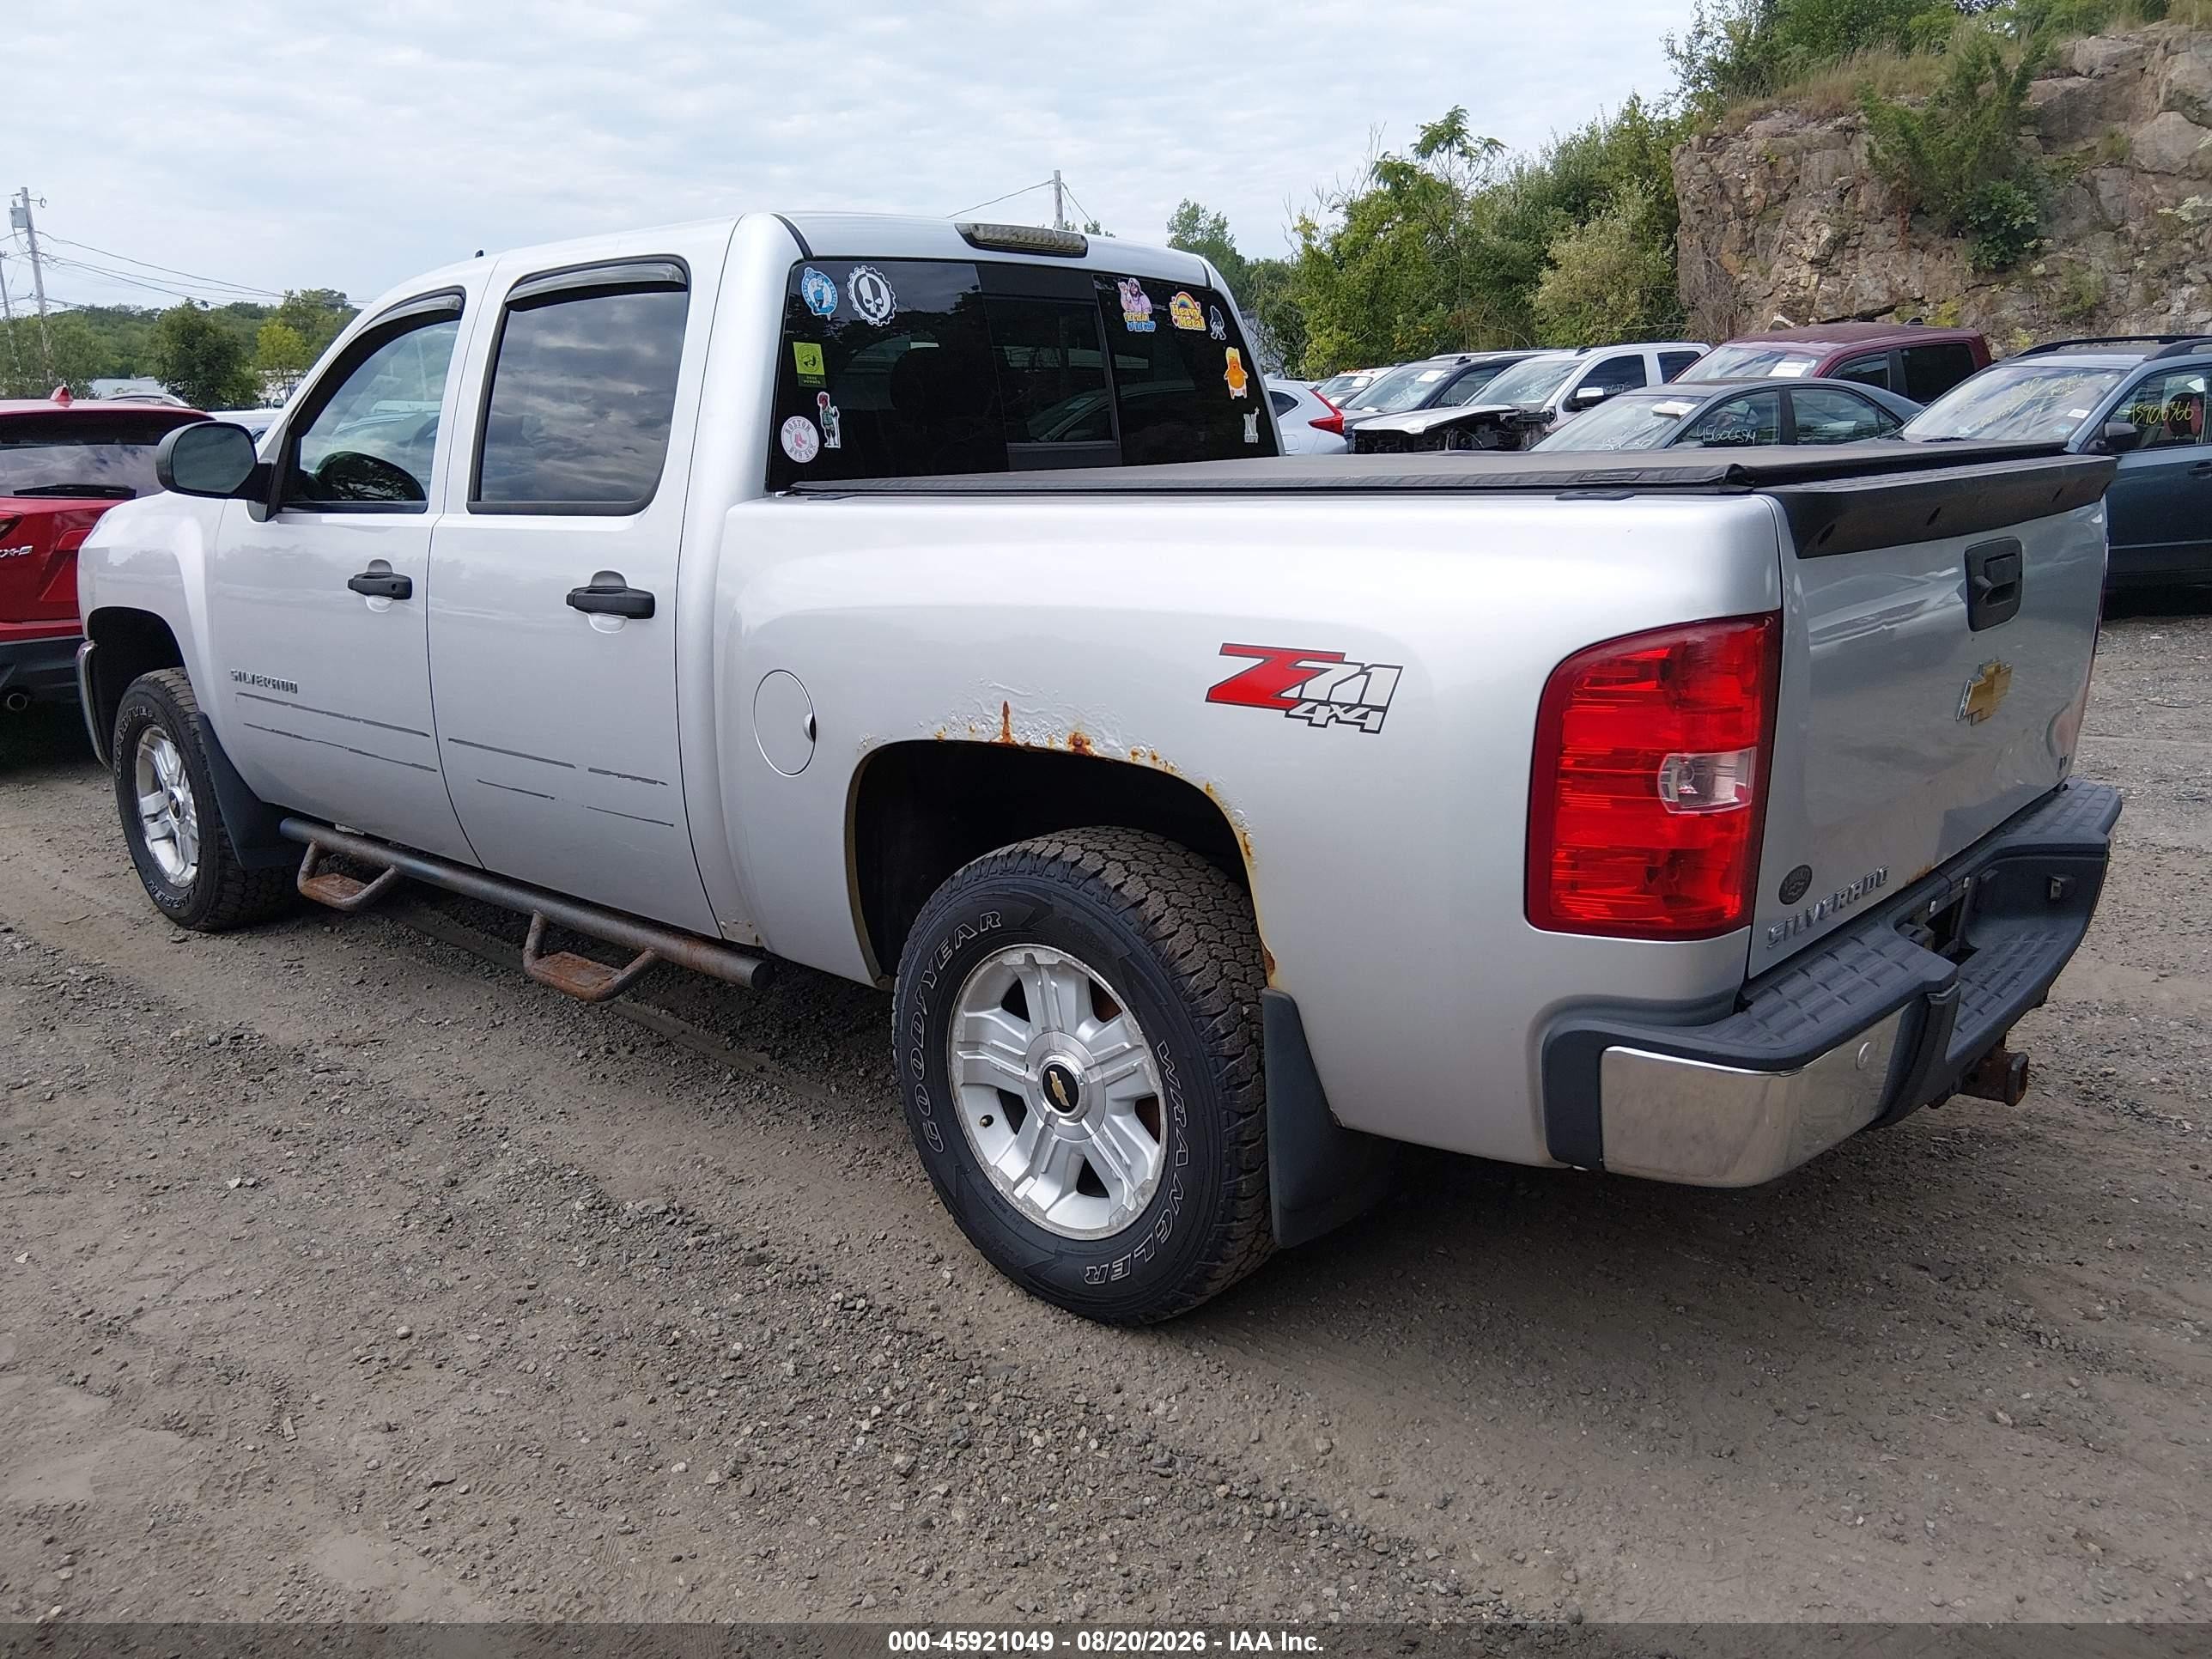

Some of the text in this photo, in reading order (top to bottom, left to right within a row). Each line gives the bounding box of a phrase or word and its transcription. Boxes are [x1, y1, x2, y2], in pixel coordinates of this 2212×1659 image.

[1170, 304, 1200, 319] Heavy
[1178, 315, 1205, 330] Metal
[785, 419, 811, 434] BOSTON
[230, 668, 298, 695] SILVERADO
[1205, 642, 1404, 711] Z71
[1766, 865, 1891, 949] SILVERADO
[910, 910, 1001, 1153] GOODYEAR
[1084, 1039, 1188, 1285] WRANGLER
